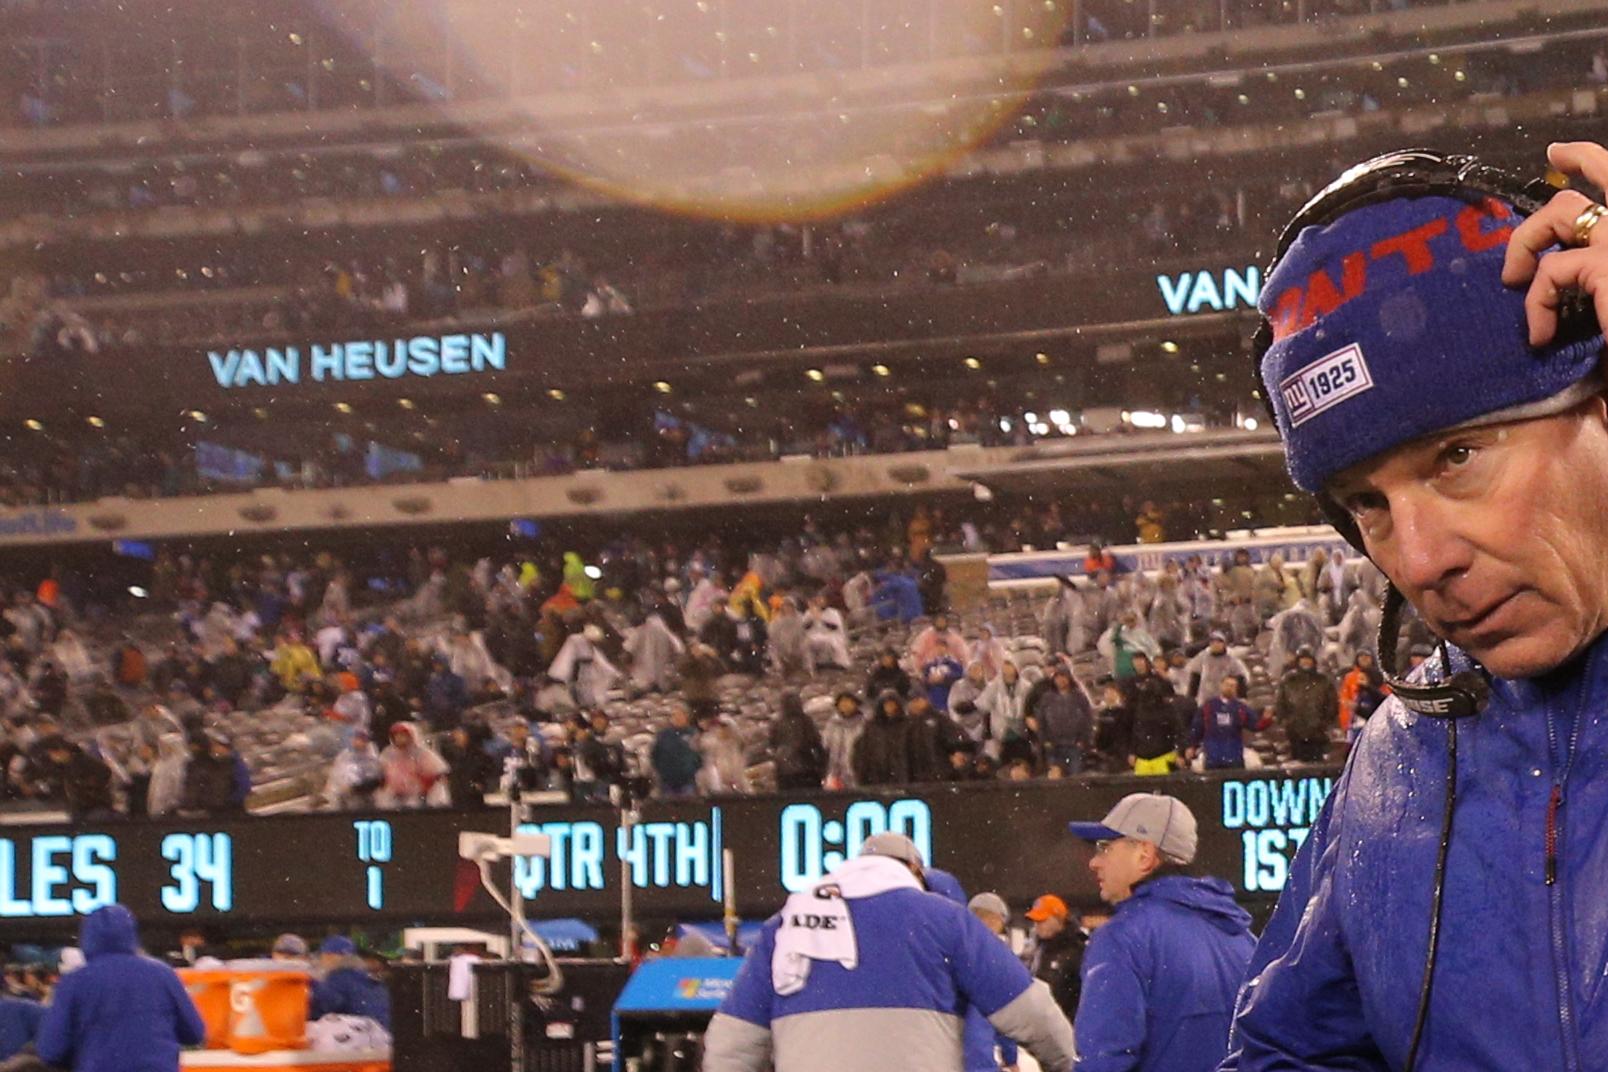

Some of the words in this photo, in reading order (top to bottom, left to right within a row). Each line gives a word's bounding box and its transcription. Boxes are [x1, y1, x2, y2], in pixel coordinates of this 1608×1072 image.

[1157, 266, 1260, 315] VAN
[208, 345, 300, 388] VAN
[310, 332, 506, 382] HEUSEN
[1309, 358, 1357, 400] 1925
[1223, 777, 1332, 828] DOWN
[353, 820, 392, 863] TO
[616, 821, 709, 889] 4TH
[161, 832, 233, 912] 34
[366, 865, 383, 910] 1
